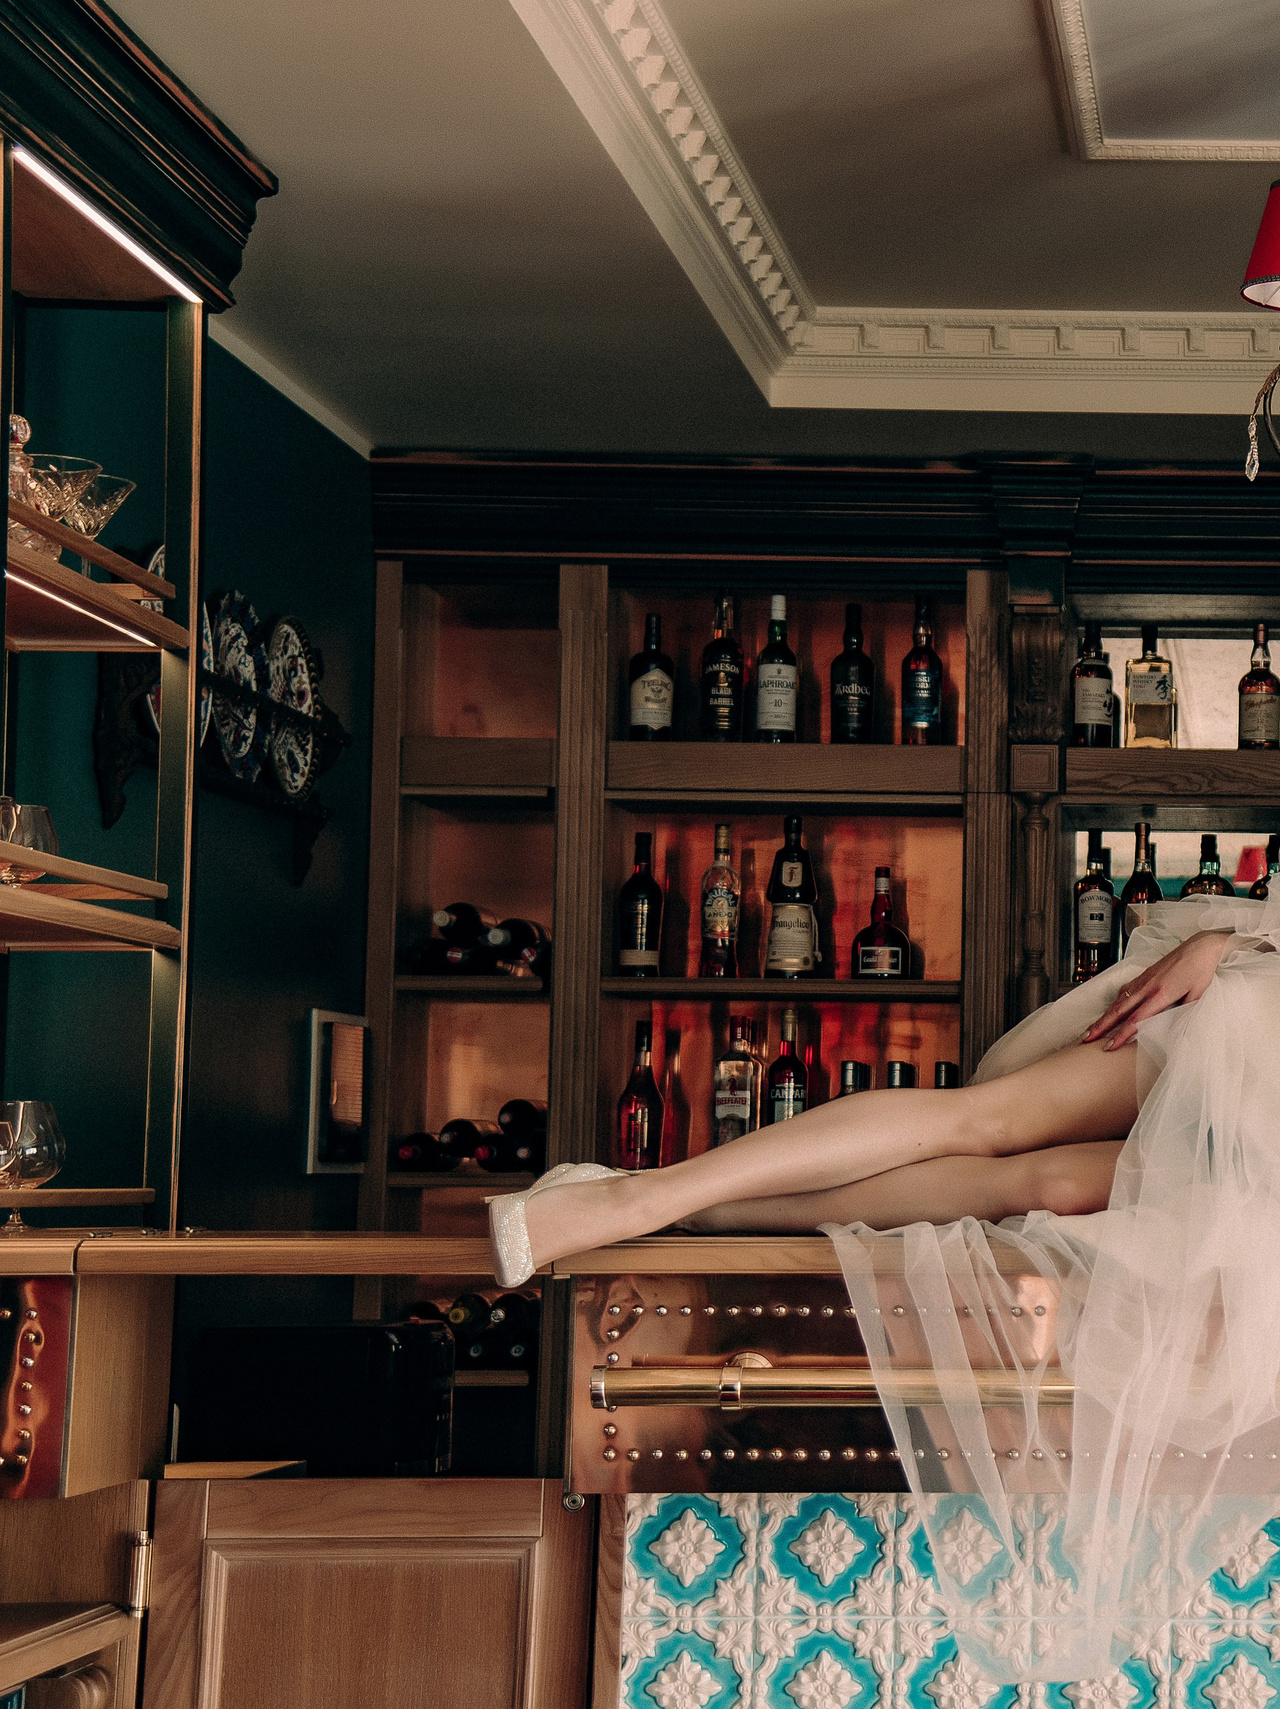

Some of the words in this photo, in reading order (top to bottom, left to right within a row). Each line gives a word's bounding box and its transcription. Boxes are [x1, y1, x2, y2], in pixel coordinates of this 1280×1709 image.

[705, 663, 740, 674] JAMESON
[641, 679, 671, 691] TEELING
[711, 687, 733, 695] BLACK
[709, 697, 734, 706] BARREL
[773, 699, 783, 707] 10
